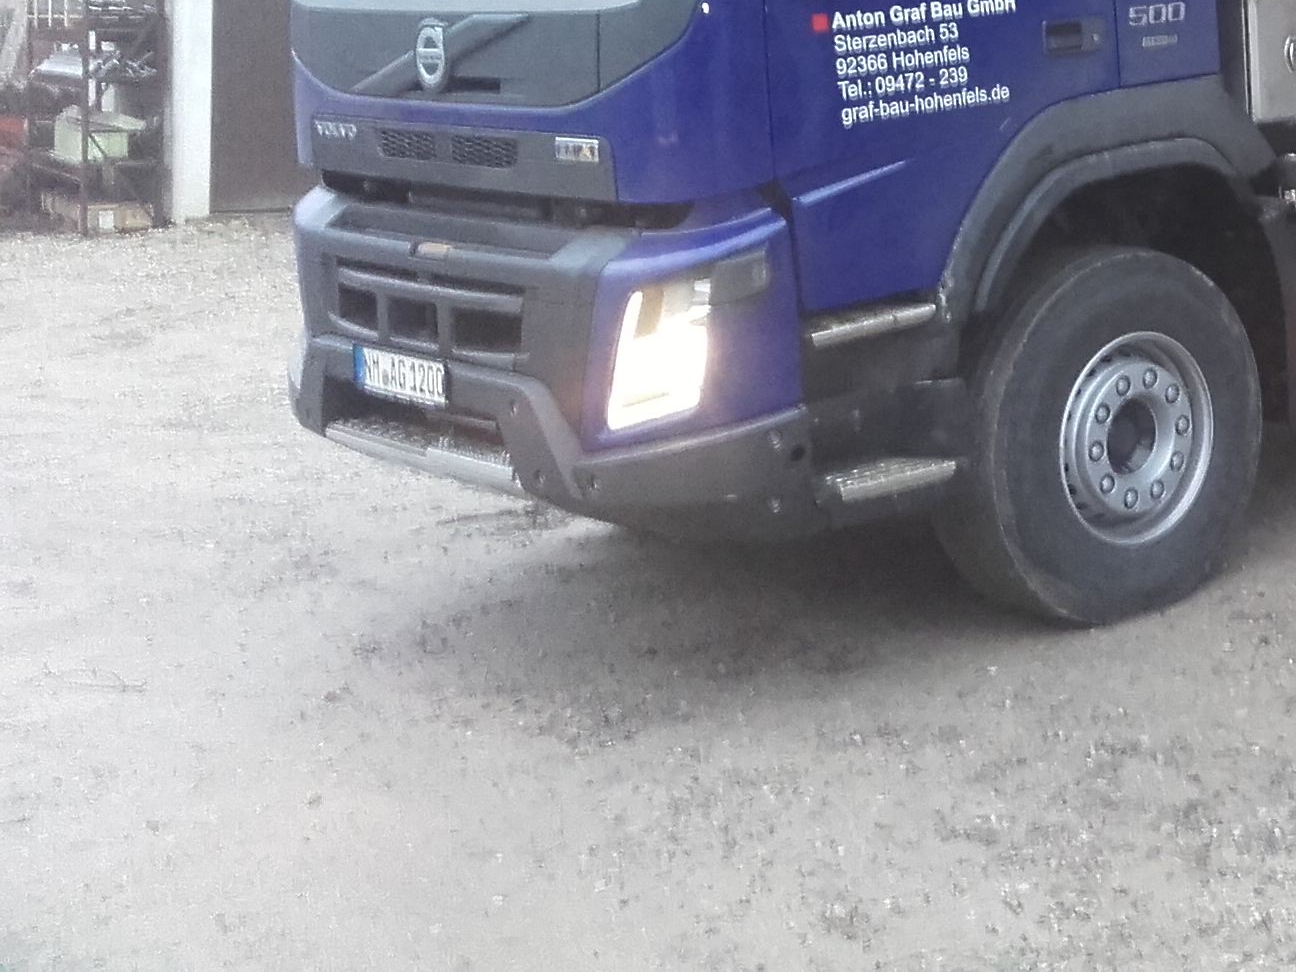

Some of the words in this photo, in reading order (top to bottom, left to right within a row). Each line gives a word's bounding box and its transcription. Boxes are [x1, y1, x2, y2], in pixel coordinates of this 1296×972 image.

[832, 11, 885, 31] Anton
[889, 3, 926, 23] Graf
[930, 0, 963, 18] Bau
[1129, 2, 1186, 26] 500
[834, 25, 935, 54] Sterzenbach
[939, 22, 958, 40] 53
[836, 53, 888, 76] 92366
[892, 45, 970, 70] Hohenfels
[838, 79, 872, 100] Tel.:
[875, 71, 924, 94] 09472
[939, 66, 968, 85] 239
[842, 84, 1010, 128] graf-bau-hohenfels.de
